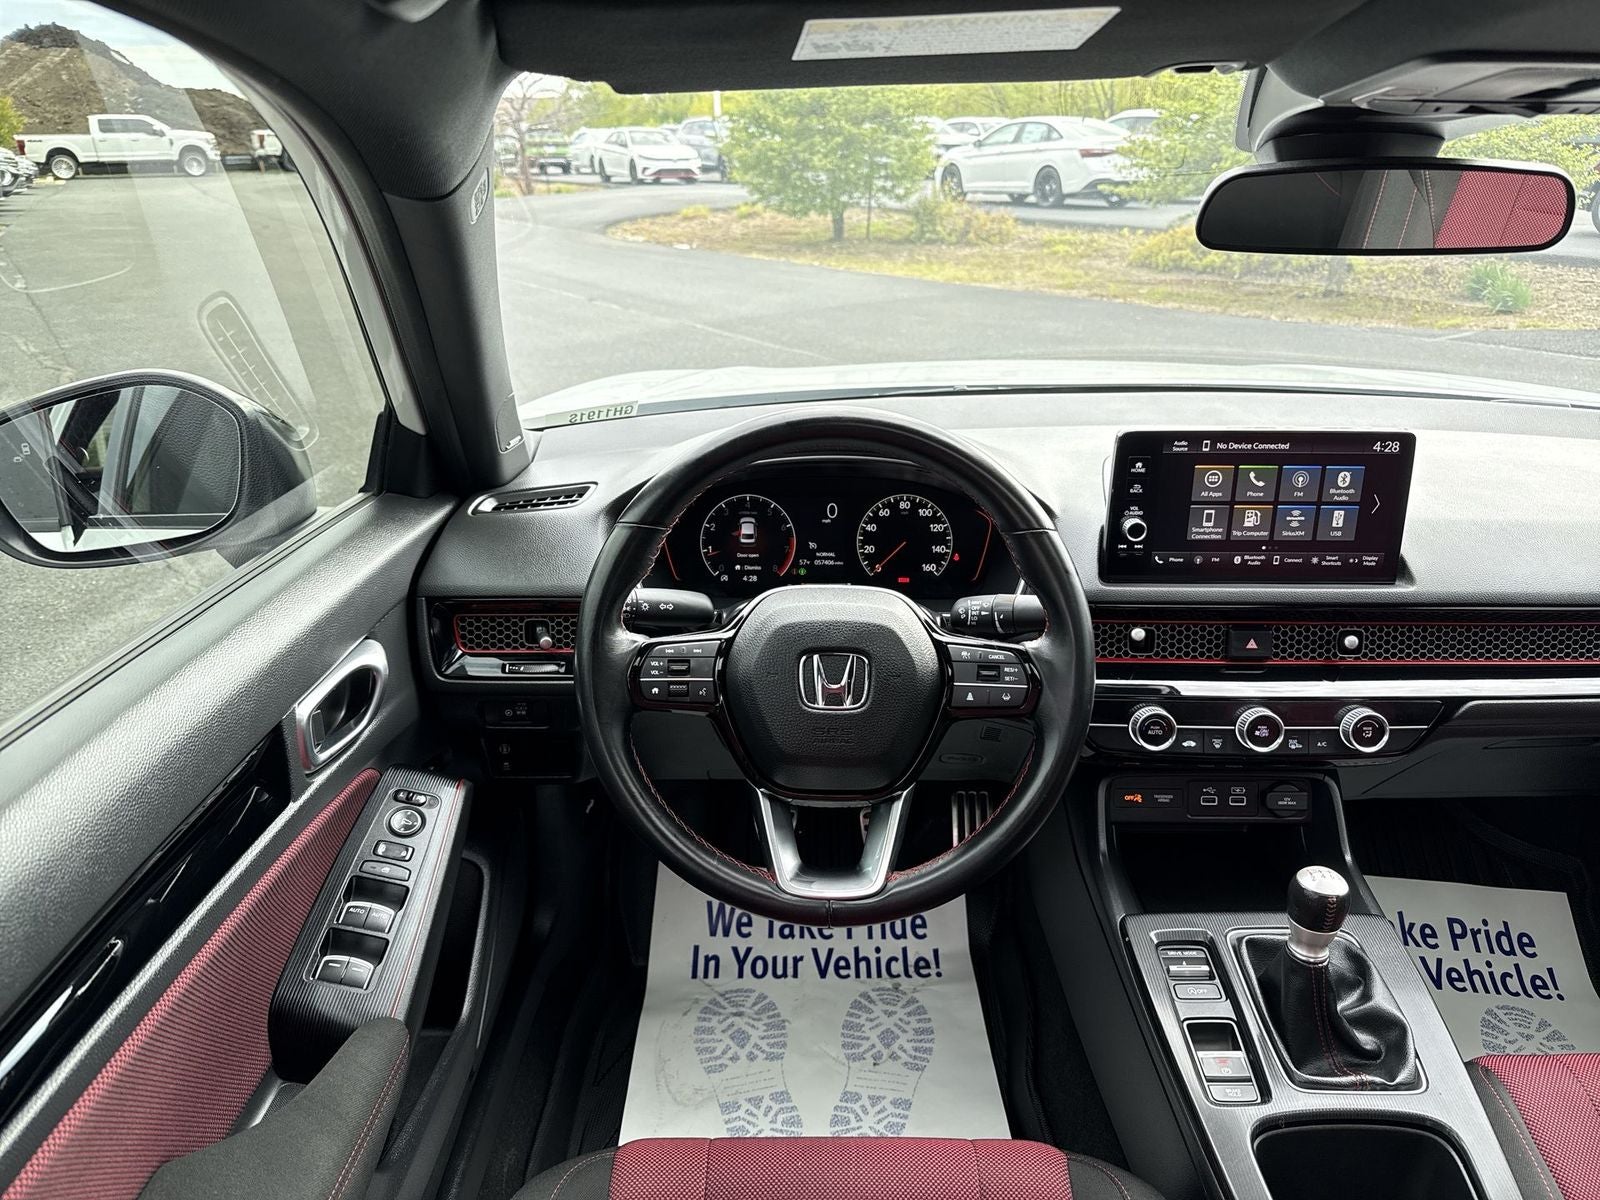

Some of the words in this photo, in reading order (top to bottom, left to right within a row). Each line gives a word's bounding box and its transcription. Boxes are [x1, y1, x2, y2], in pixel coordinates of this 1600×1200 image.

[1373, 441, 1400, 452] 4:28
[827, 503, 838, 518] 0
[706, 900, 752, 938] We
[1446, 917, 1538, 959] Pride
[691, 945, 721, 980] In
[731, 946, 804, 979] Your
[811, 946, 942, 979] Vehicle!
[1419, 956, 1565, 1002] Vehicle!
